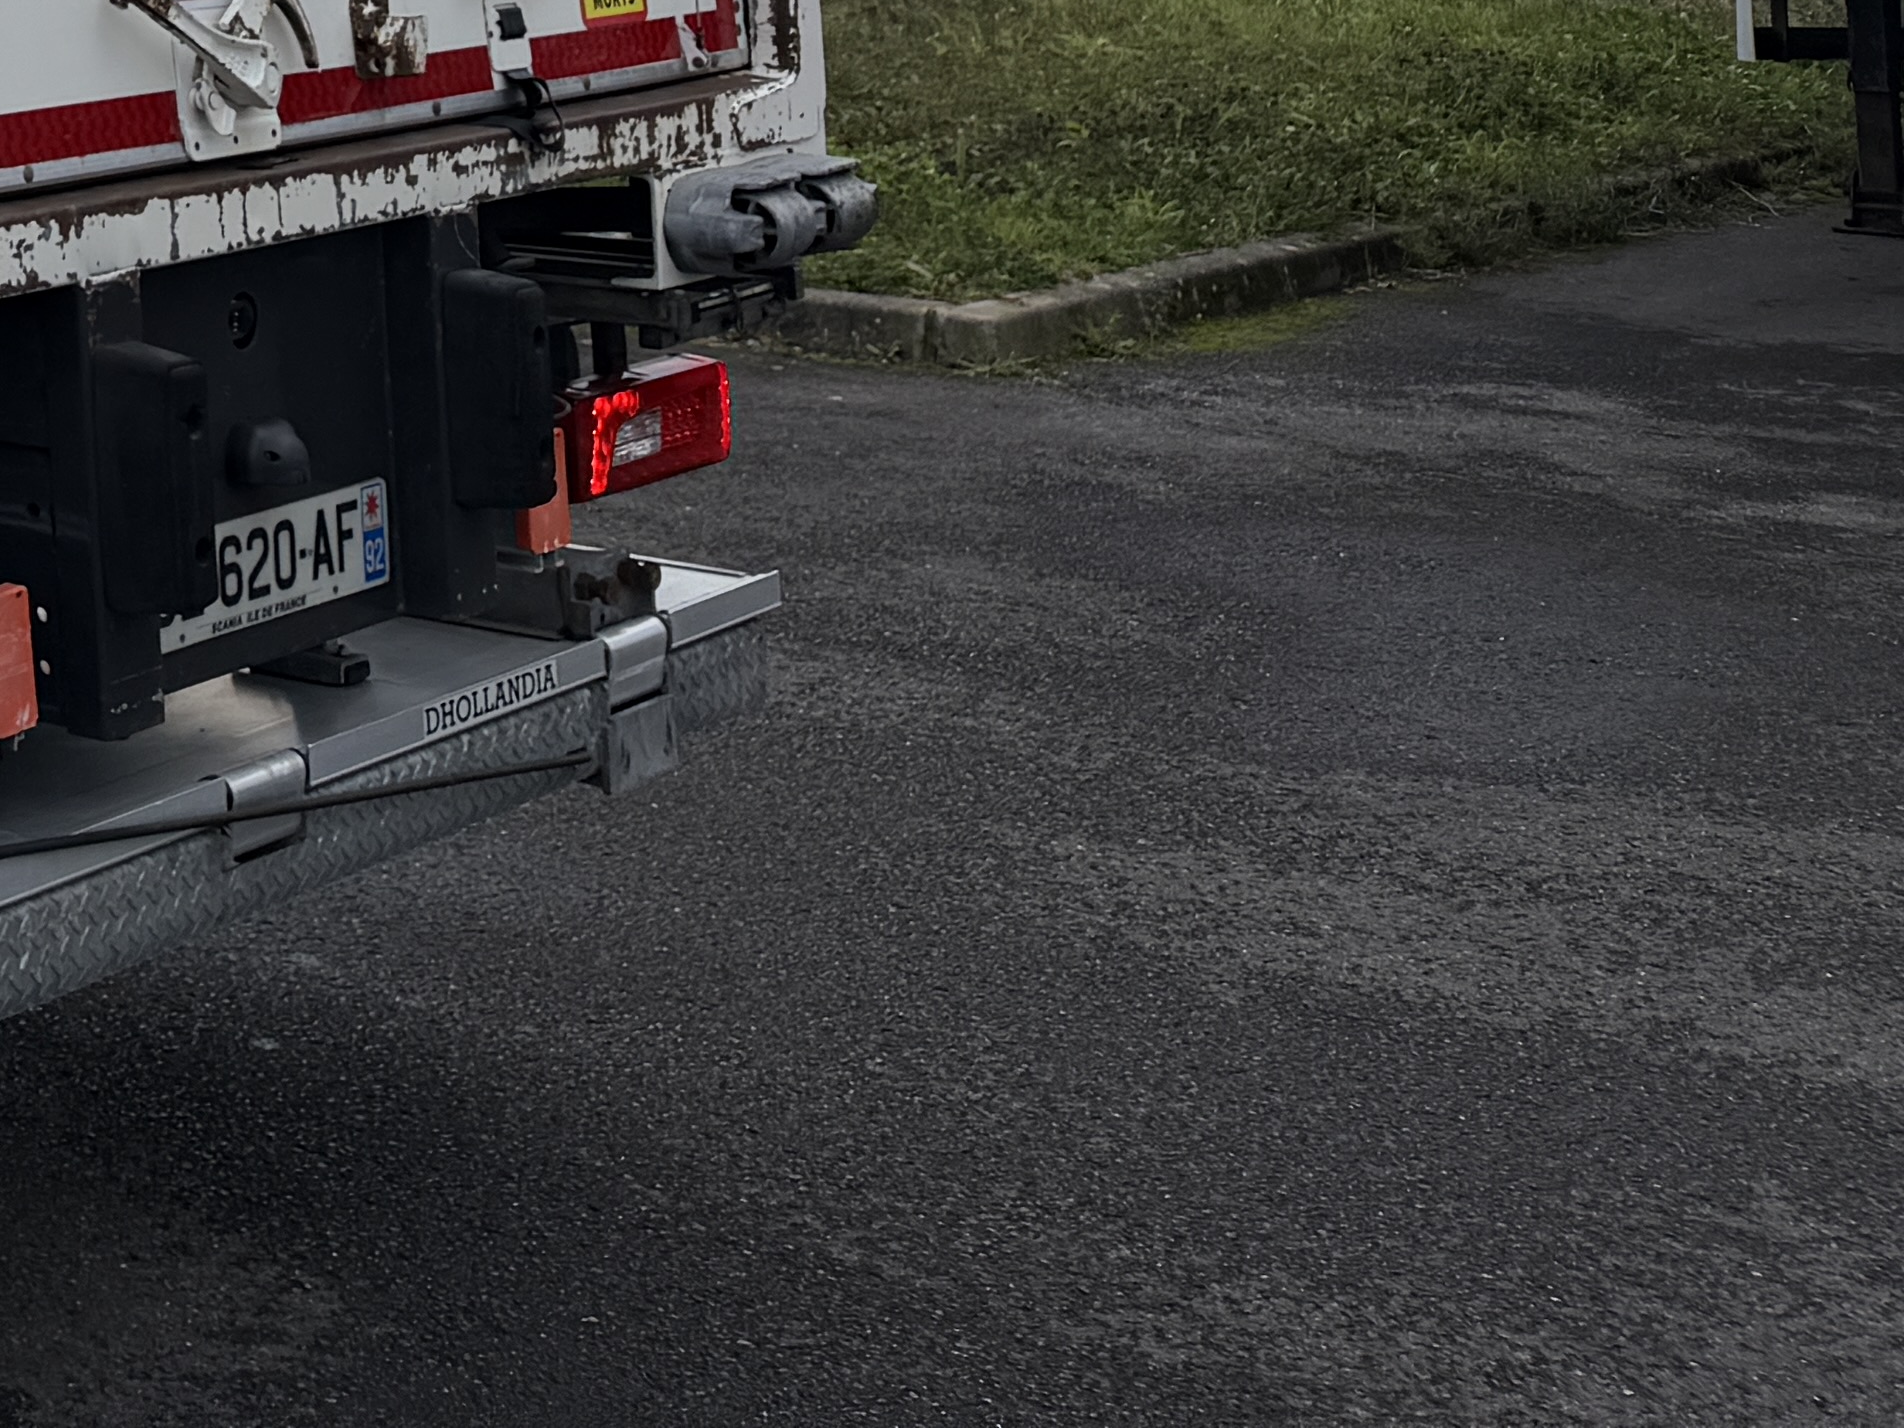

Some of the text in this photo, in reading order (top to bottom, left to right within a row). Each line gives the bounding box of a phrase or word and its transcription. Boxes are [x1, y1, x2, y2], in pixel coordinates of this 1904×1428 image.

[364, 537, 385, 574] 92
[262, 606, 272, 618] DE
[275, 594, 307, 613] FRANCE
[424, 662, 558, 737] DHOLLANDIA
